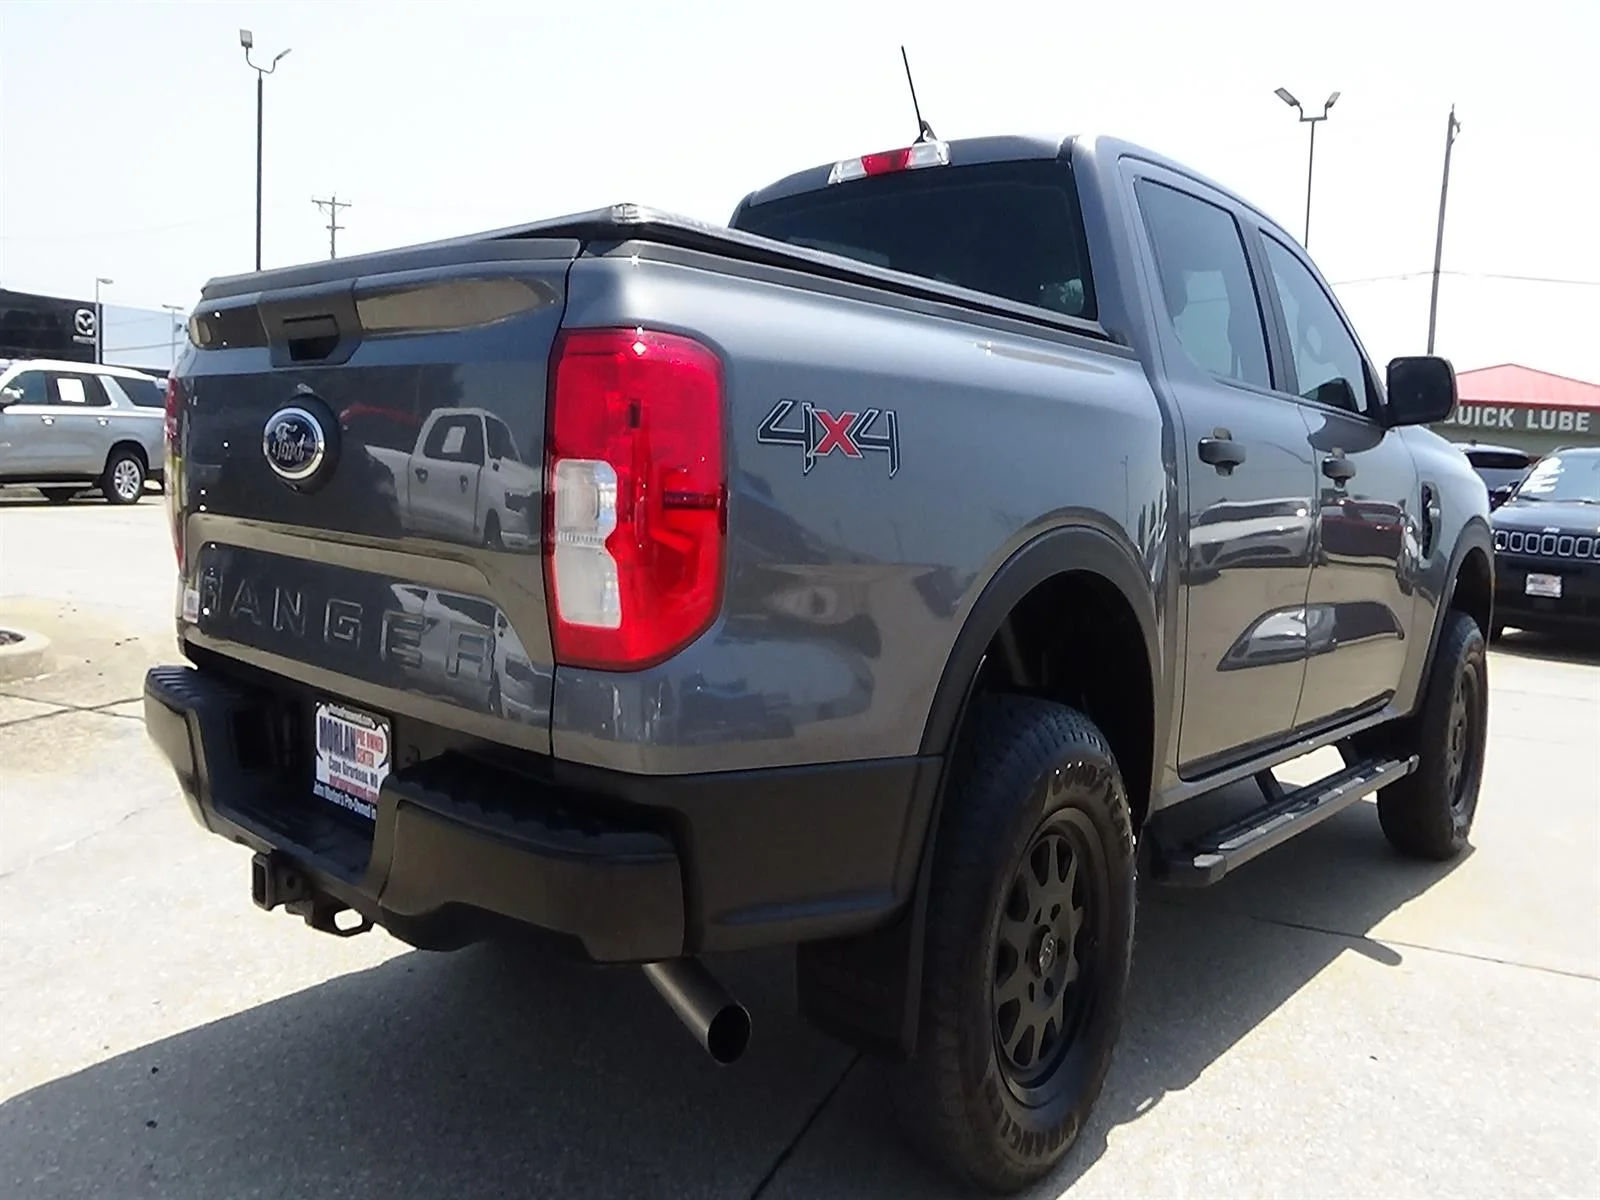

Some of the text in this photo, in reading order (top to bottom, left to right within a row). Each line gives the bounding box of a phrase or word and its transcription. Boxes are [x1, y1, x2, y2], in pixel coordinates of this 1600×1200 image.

[1527, 409, 1590, 432] LUBE
[271, 422, 306, 462] Ford
[201, 568, 495, 682] RANGER
